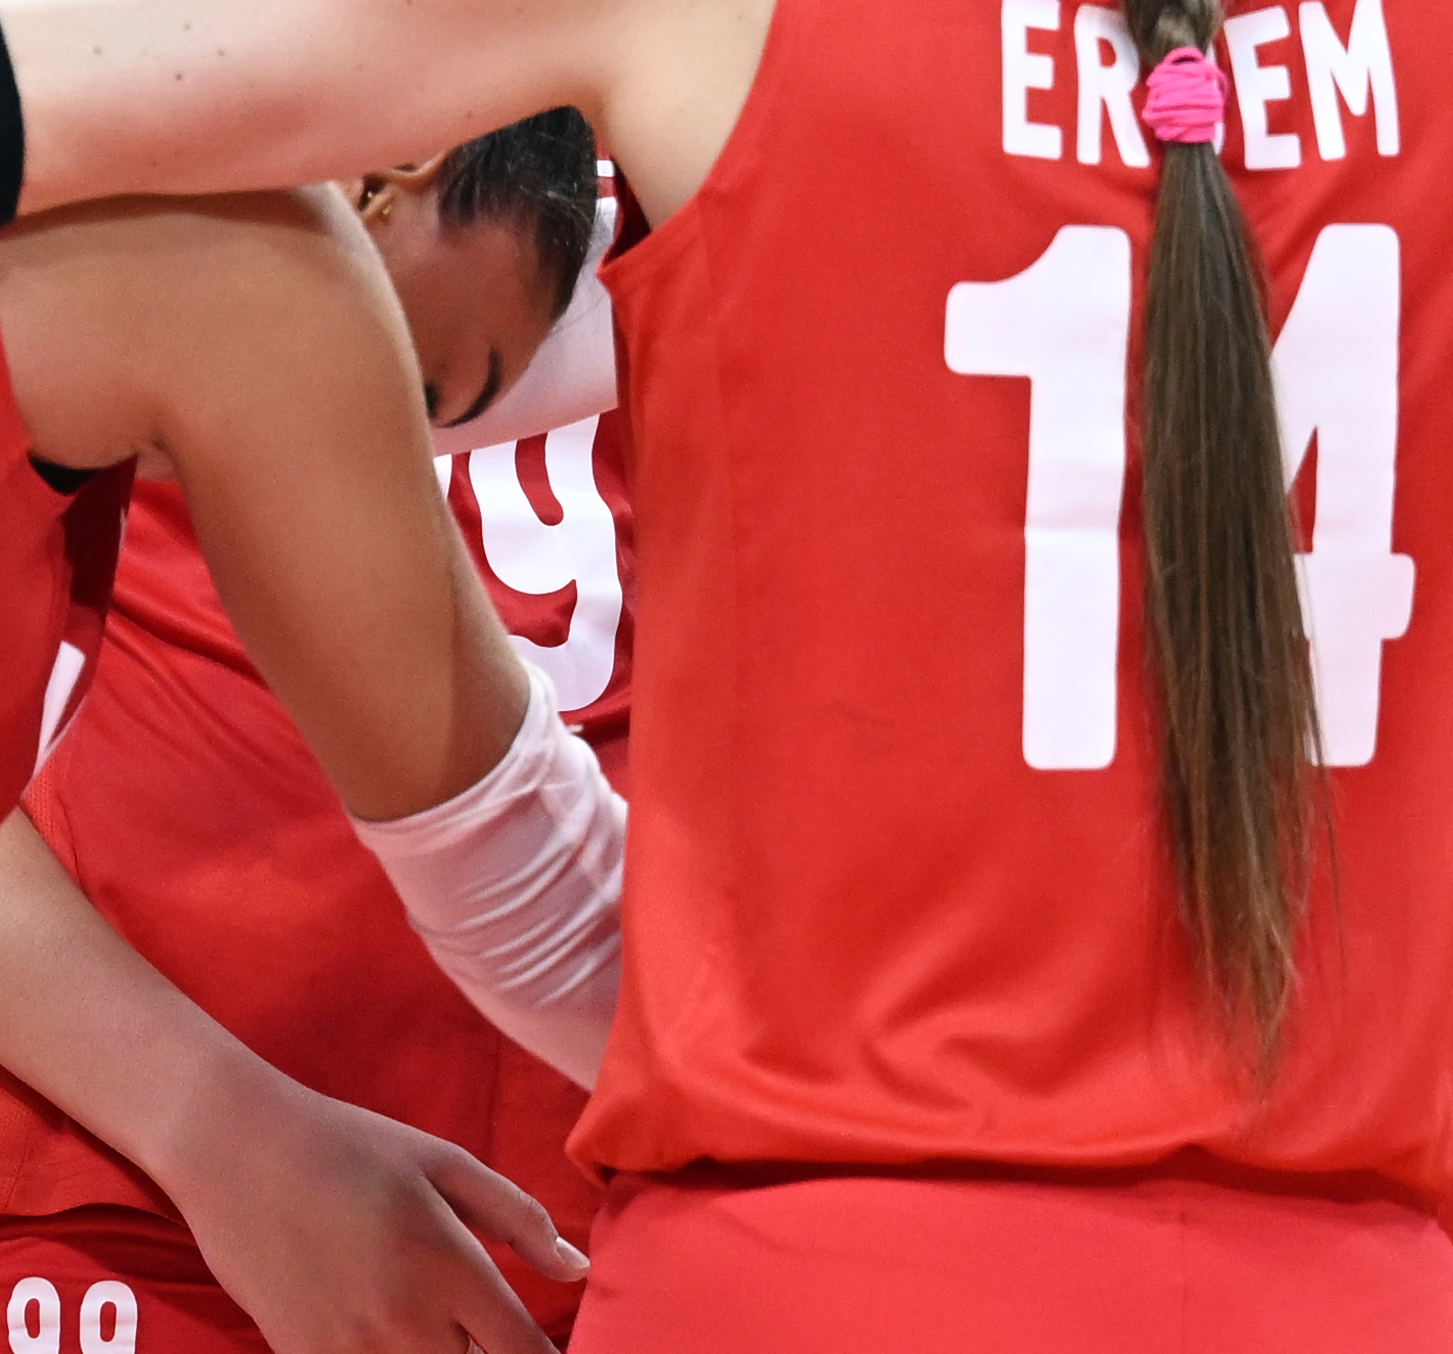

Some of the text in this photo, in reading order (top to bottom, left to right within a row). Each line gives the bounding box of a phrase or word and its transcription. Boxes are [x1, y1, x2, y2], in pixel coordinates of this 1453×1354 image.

[432, 413, 623, 712] 9
[944, 224, 1416, 770] 14
[6, 1276, 139, 1354] 99
